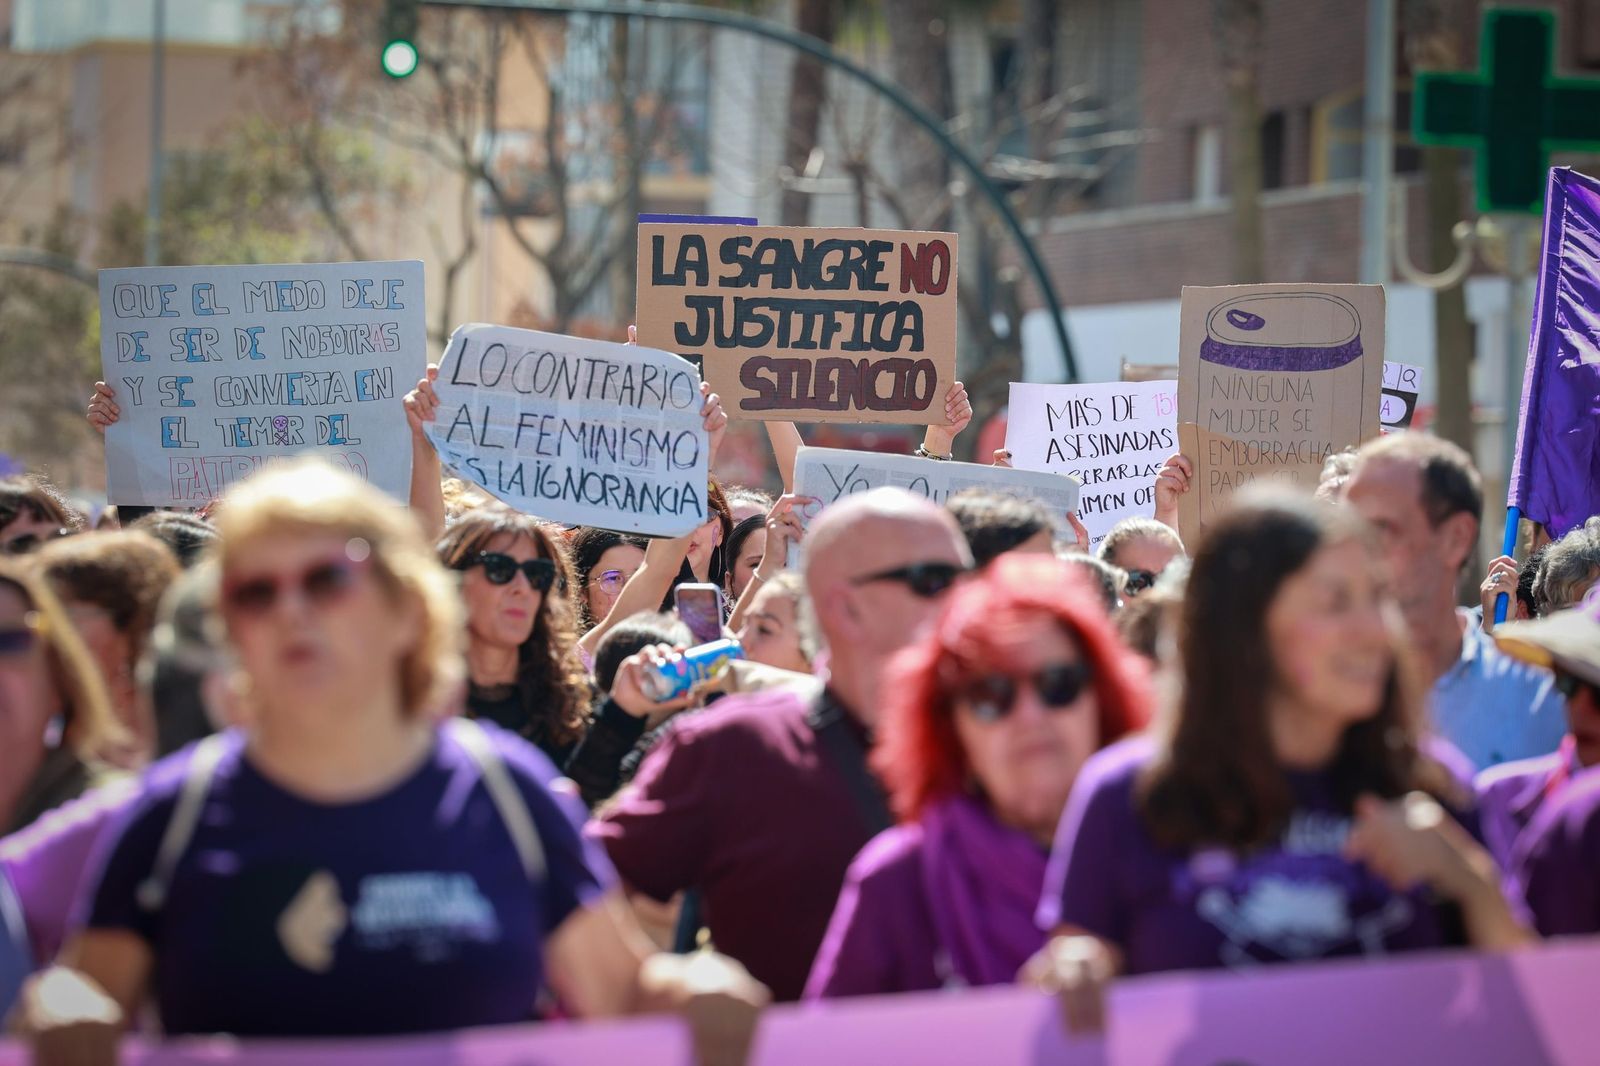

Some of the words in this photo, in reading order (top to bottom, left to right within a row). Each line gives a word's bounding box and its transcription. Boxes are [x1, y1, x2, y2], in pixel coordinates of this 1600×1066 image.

[652, 234, 709, 287] LA
[718, 236, 894, 292] SANGRE
[900, 239, 950, 295] NO
[113, 283, 180, 318] QUE
[192, 282, 230, 316] EL
[243, 279, 325, 313] MIEDO
[341, 279, 404, 310] DEJE
[117, 331, 150, 362] DE
[170, 327, 223, 362] SER
[234, 326, 265, 360] DE
[282, 322, 400, 360] NOSOTRAS
[674, 295, 925, 352] JUSTIFICA
[123, 376, 144, 405] Y
[158, 376, 196, 407] SE
[214, 371, 352, 407] CONVIERTA
[354, 367, 394, 402] EN
[451, 338, 508, 388] LO
[511, 350, 694, 410] CONTRARIO
[739, 355, 937, 411] SILENCIO
[1210, 373, 1314, 403] NINGUNA
[161, 416, 199, 449] EL
[315, 414, 361, 446] DEL
[446, 403, 505, 449] AL
[1046, 393, 1102, 432] MÁS
[1112, 394, 1140, 422] DE
[1208, 408, 1279, 434] MUJER
[1292, 408, 1313, 433] SE
[1046, 428, 1173, 464] ASESINADAS
[1209, 439, 1334, 466] EMBORRACHA
[1076, 492, 1125, 520] IMEN
